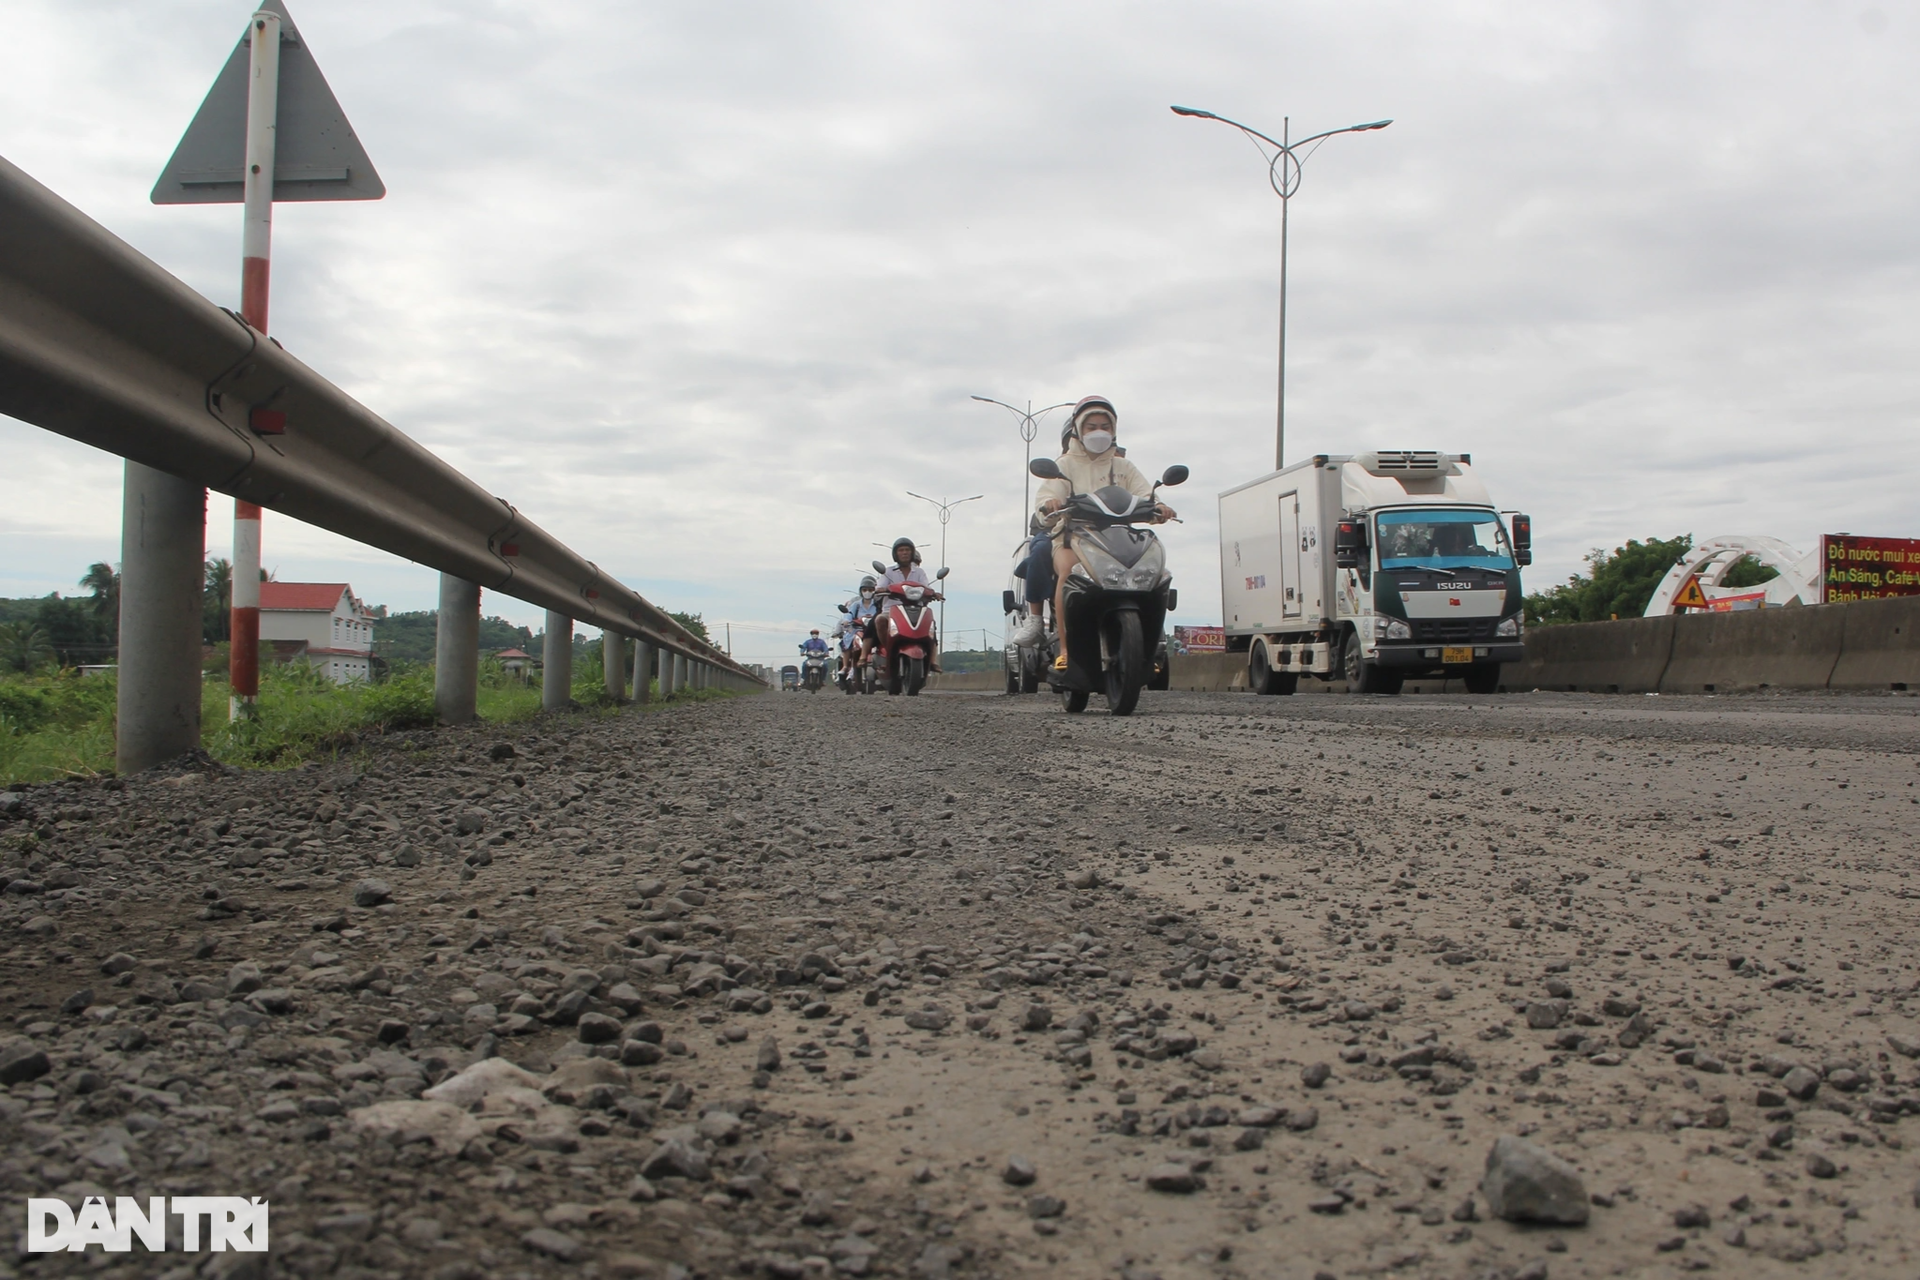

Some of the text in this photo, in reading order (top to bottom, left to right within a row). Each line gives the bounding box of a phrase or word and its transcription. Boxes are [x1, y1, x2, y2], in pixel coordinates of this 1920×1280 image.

[1848, 546, 1880, 561] nước
[1883, 548, 1905, 562] mui
[1828, 563, 1845, 582] Ăn
[1849, 568, 1883, 587] Sáng,
[1885, 570, 1913, 585] Café
